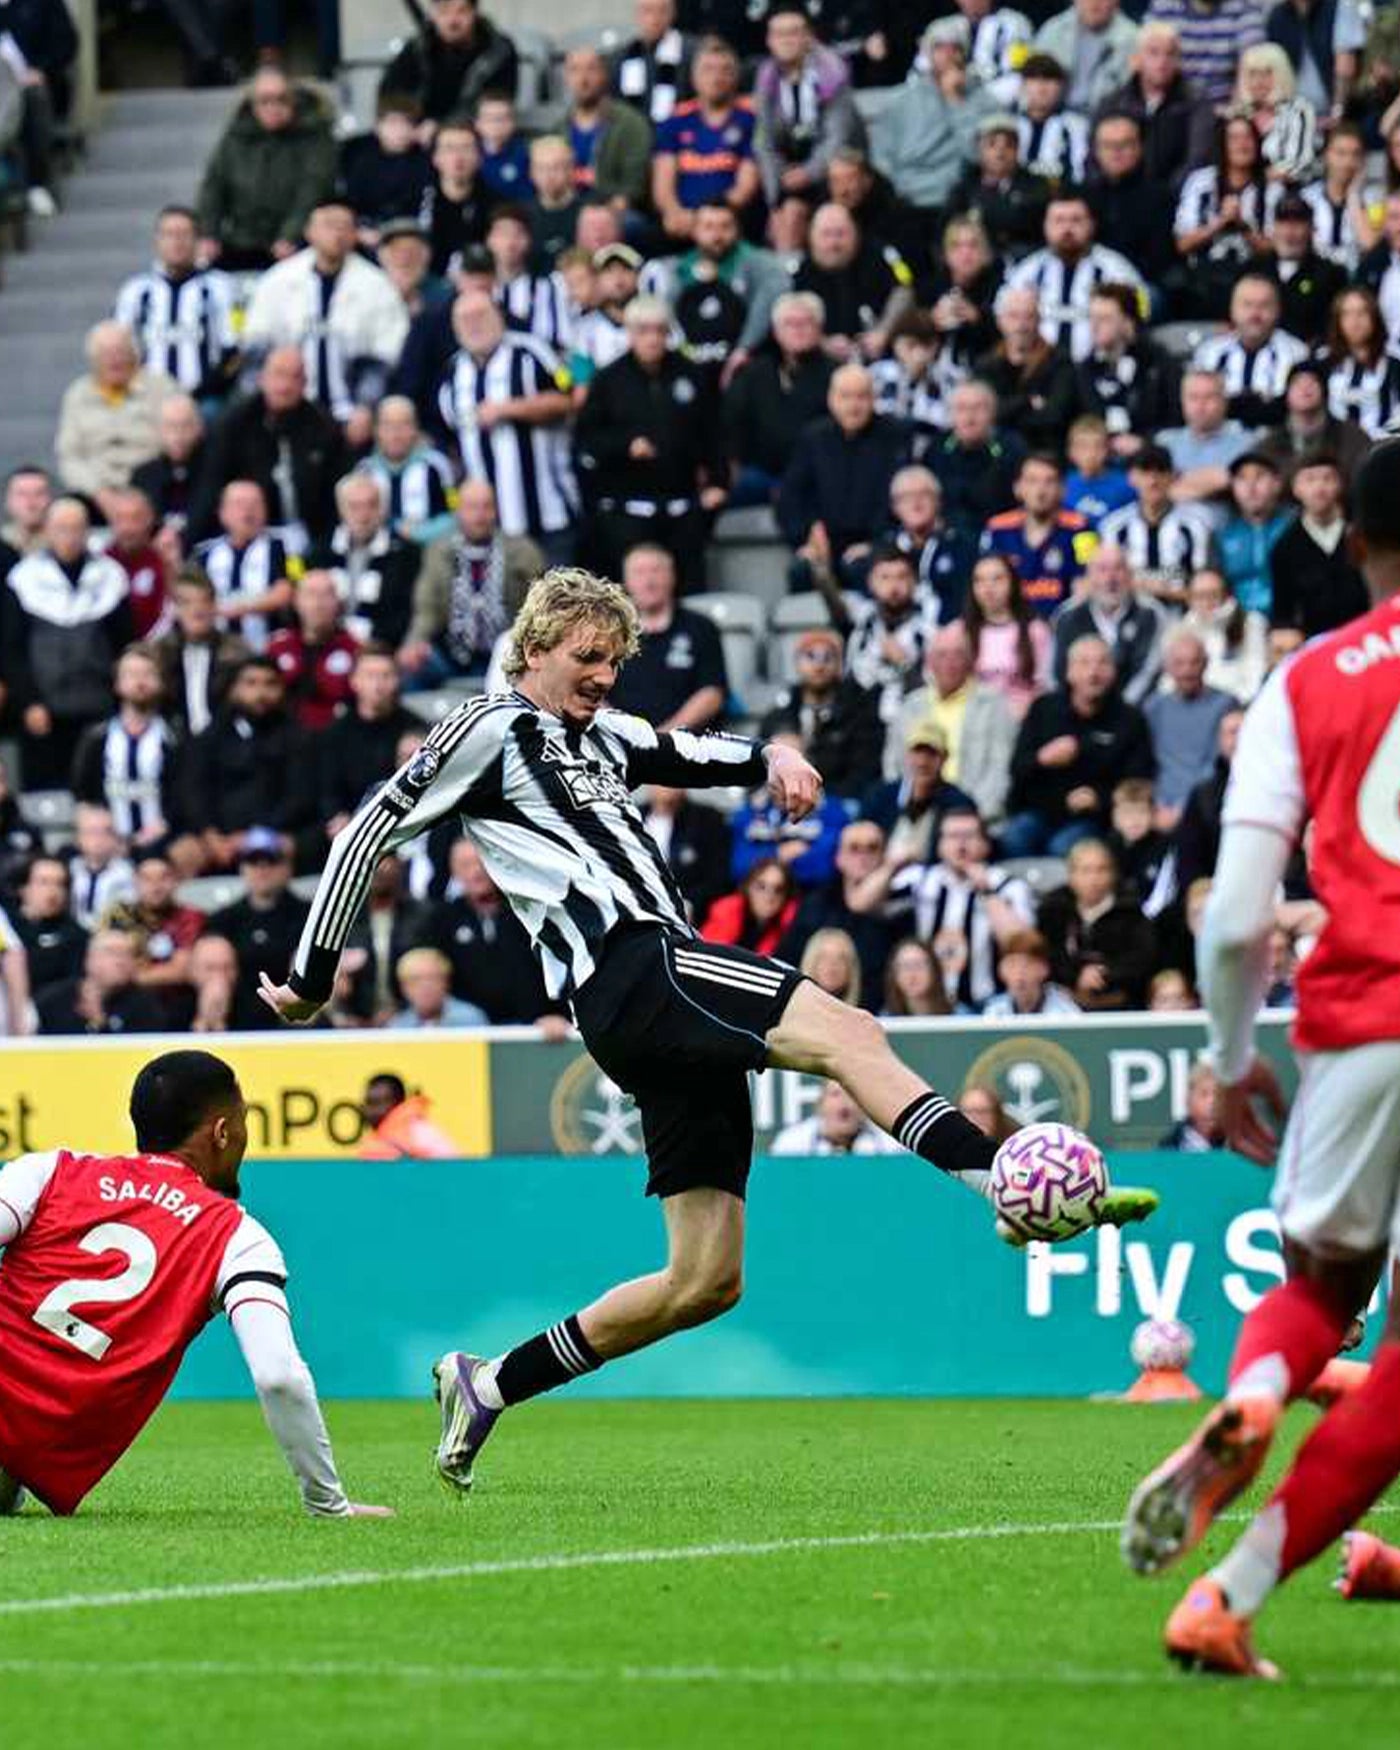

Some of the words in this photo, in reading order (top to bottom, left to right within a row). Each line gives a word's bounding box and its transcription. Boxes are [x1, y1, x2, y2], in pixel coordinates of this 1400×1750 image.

[1108, 1048, 1214, 1124] PI
[98, 1175, 202, 1227] SALIBA
[32, 1221, 157, 1361] 2
